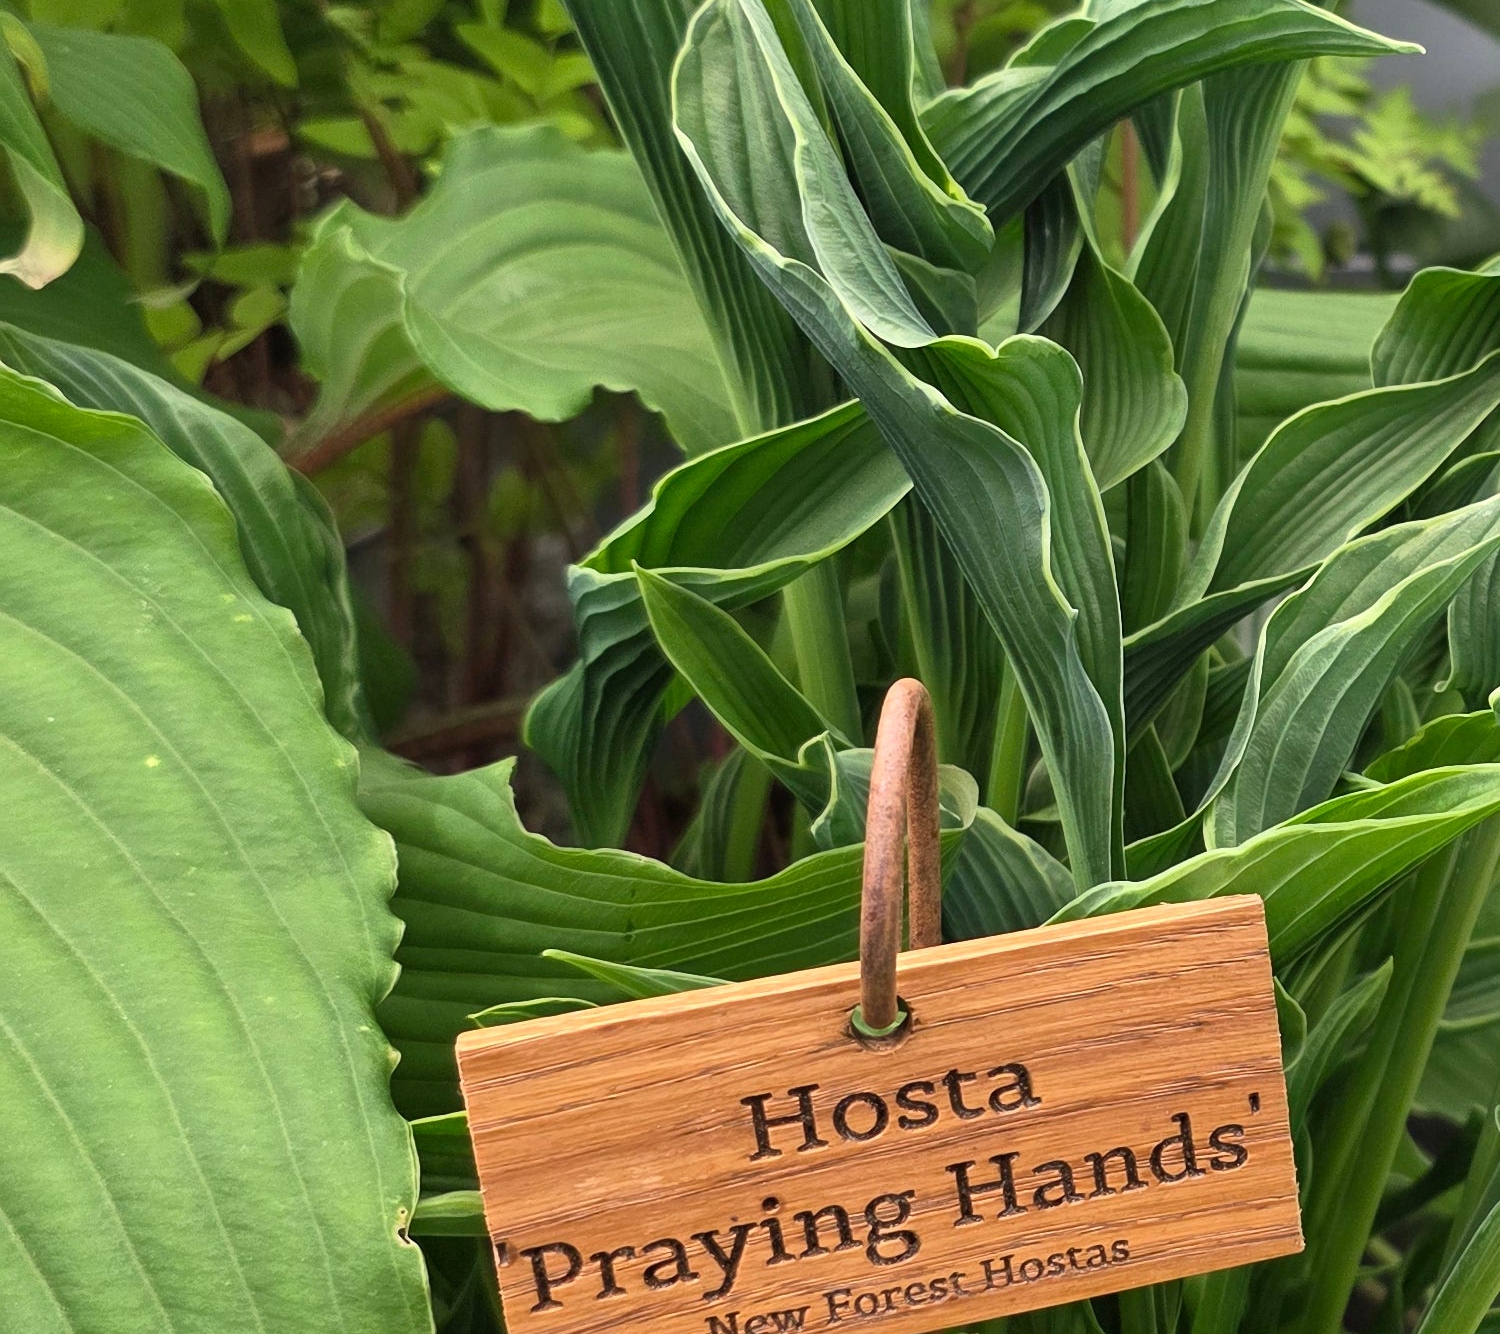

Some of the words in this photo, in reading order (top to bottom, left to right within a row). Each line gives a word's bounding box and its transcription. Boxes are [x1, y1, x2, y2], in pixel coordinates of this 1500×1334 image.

[740, 1061, 1042, 1161] Hosta
[496, 1189, 919, 1313] 'Praying
[945, 1091, 1262, 1228] Hands'
[824, 1271, 966, 1326] Forest
[980, 1238, 1132, 1292] Hostas
